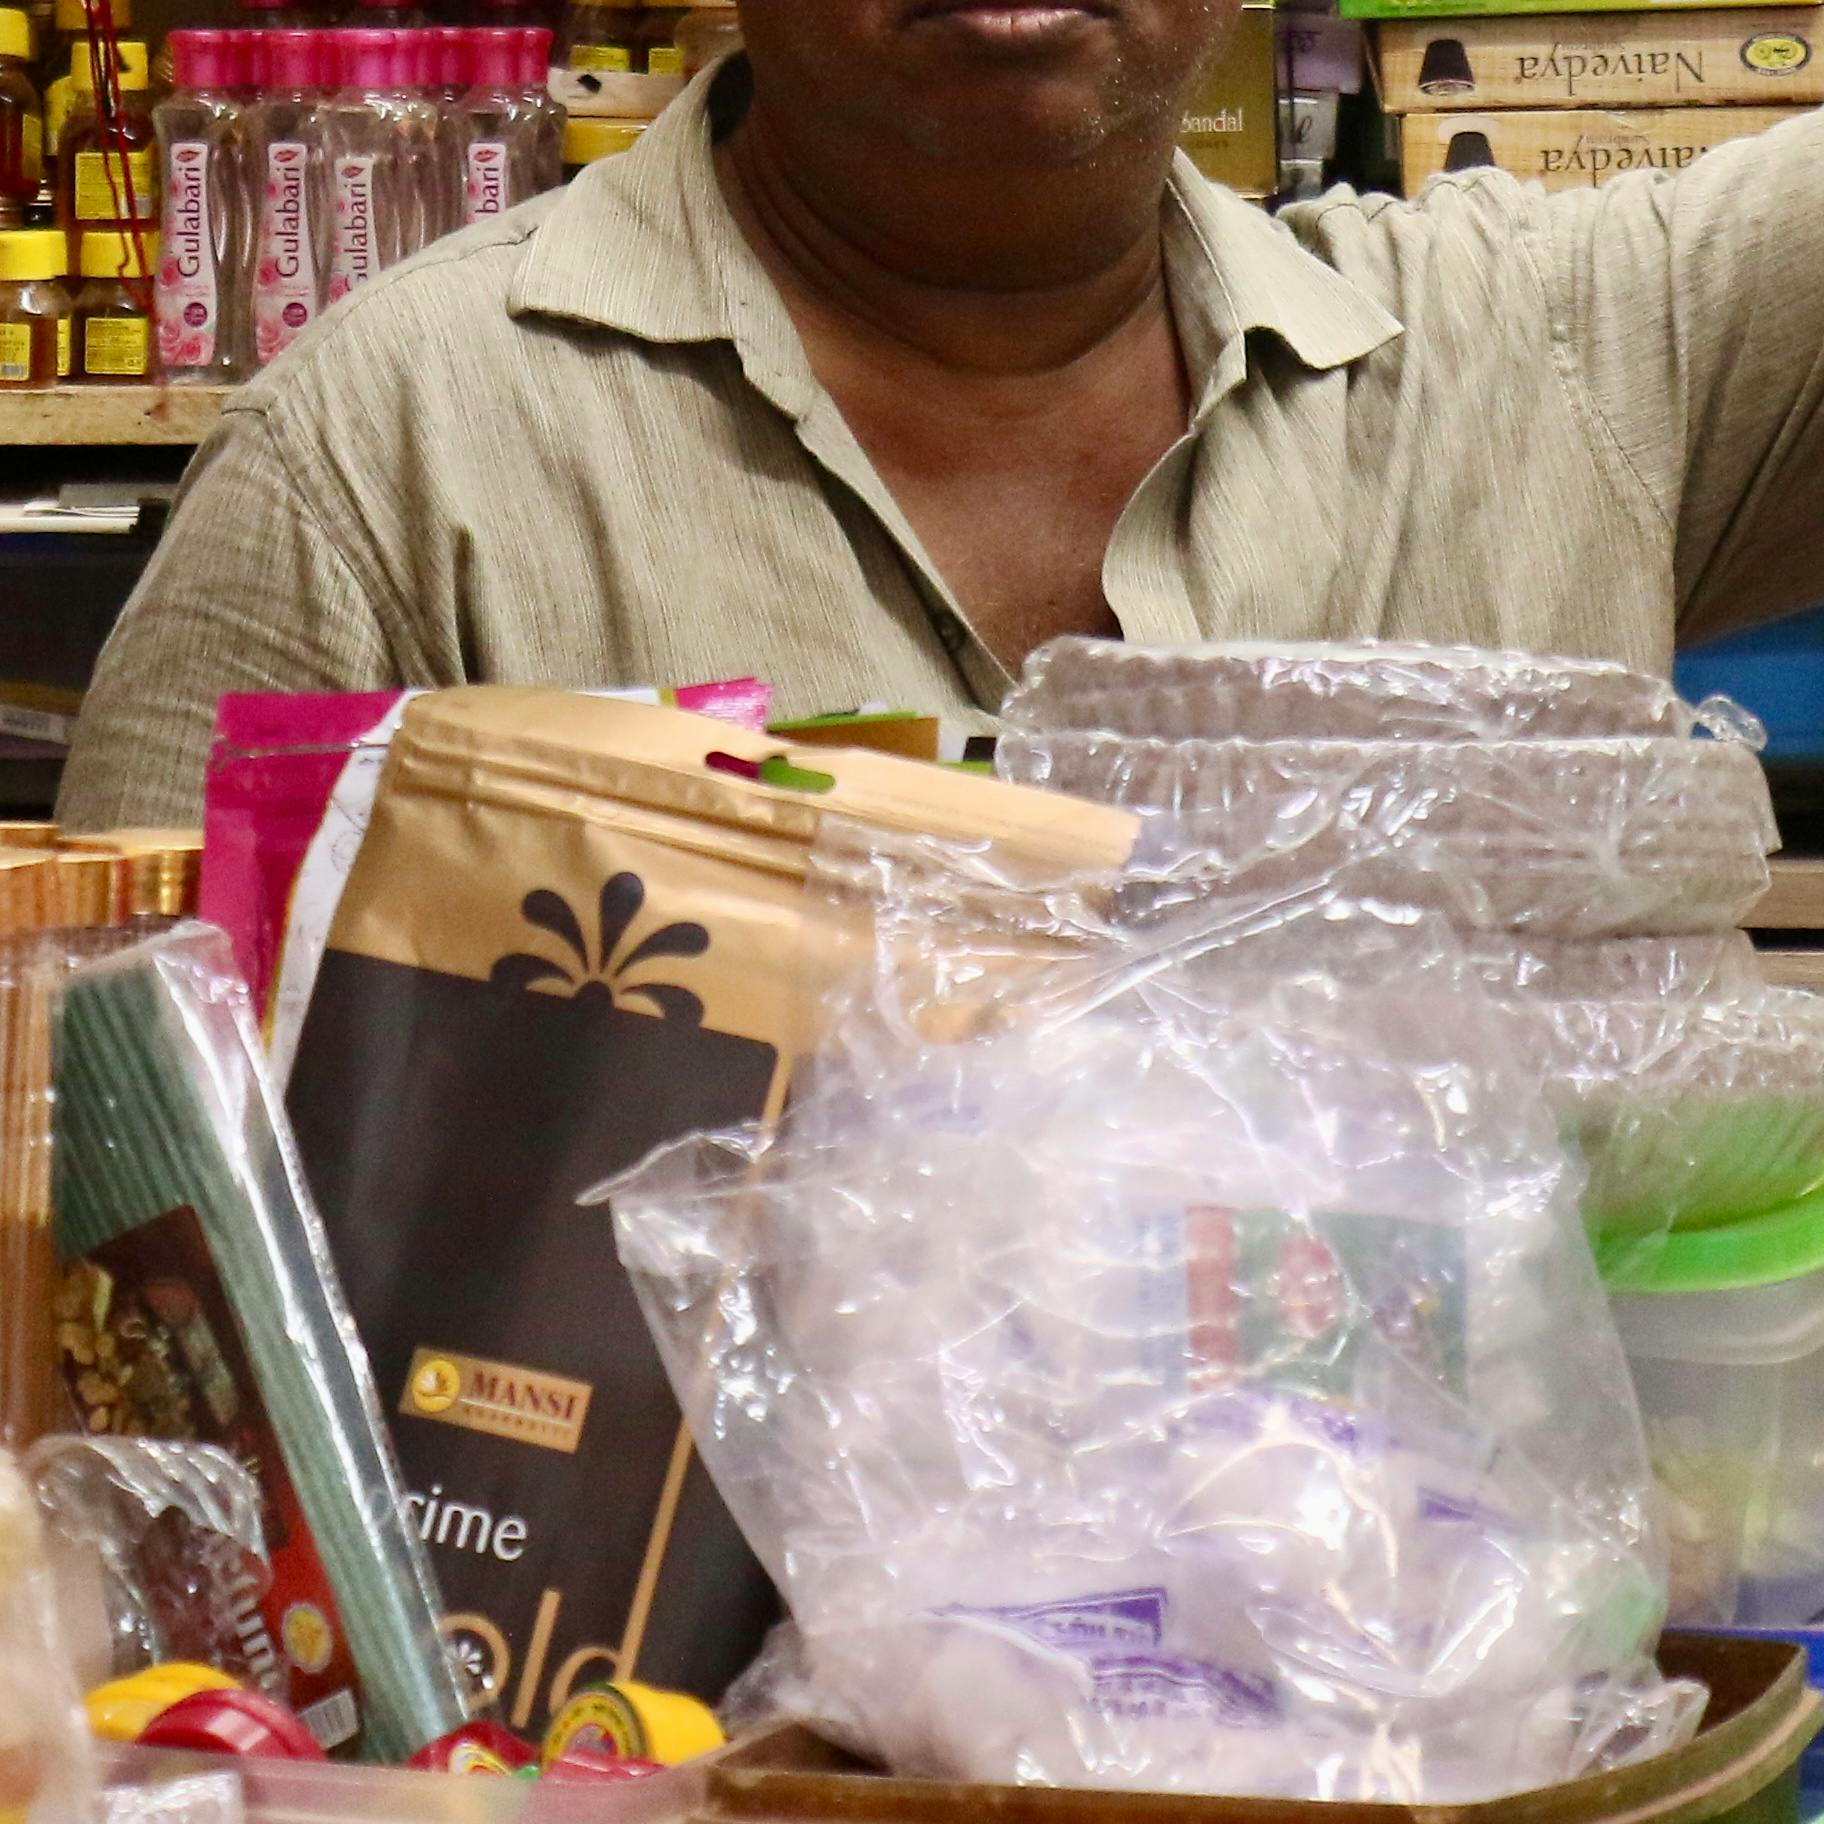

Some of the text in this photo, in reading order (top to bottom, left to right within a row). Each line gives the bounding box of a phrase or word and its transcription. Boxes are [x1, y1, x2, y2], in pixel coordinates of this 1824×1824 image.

[1514, 40, 1704, 93] Naivedya
[1540, 137, 1696, 188] aivedya
[177, 163, 203, 279] Gulabari
[274, 164, 301, 279] Gulabari
[469, 1366, 579, 1424] MANSI
